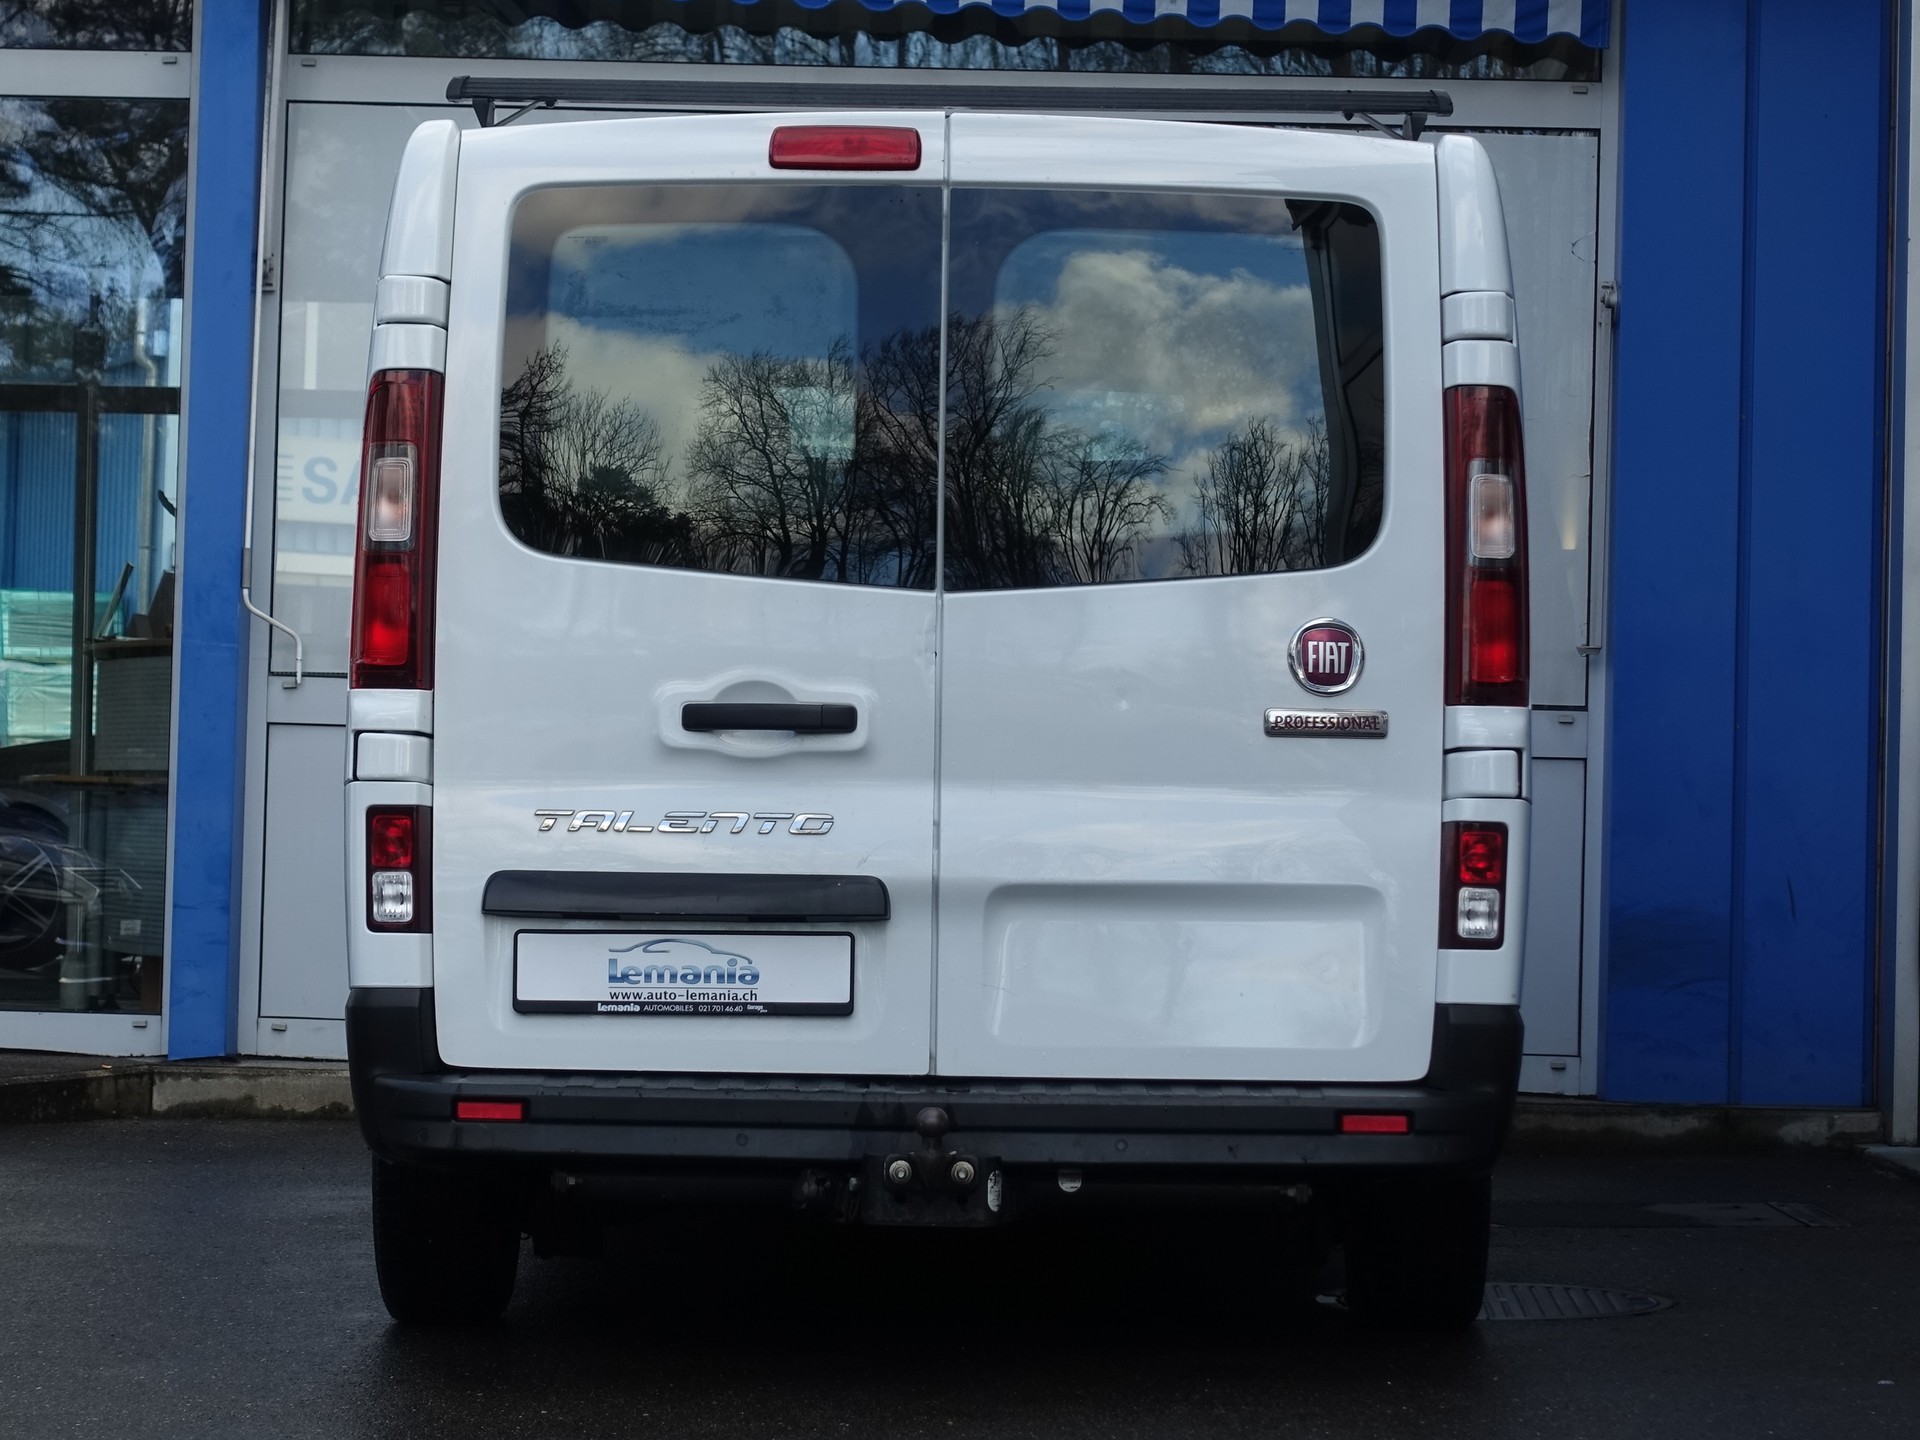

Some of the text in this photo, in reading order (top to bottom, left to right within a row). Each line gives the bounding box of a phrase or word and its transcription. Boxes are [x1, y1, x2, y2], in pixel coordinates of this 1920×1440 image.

[1308, 641, 1350, 674] FIAT
[1272, 716, 1381, 731] PROFESSIONAL
[534, 808, 835, 835] TALENTO
[608, 957, 760, 985] Lemania
[609, 989, 758, 1001] www.auto-lemania.ch
[597, 1002, 641, 1012] Lemania
[643, 1004, 694, 1012] AUTOMOBILES
